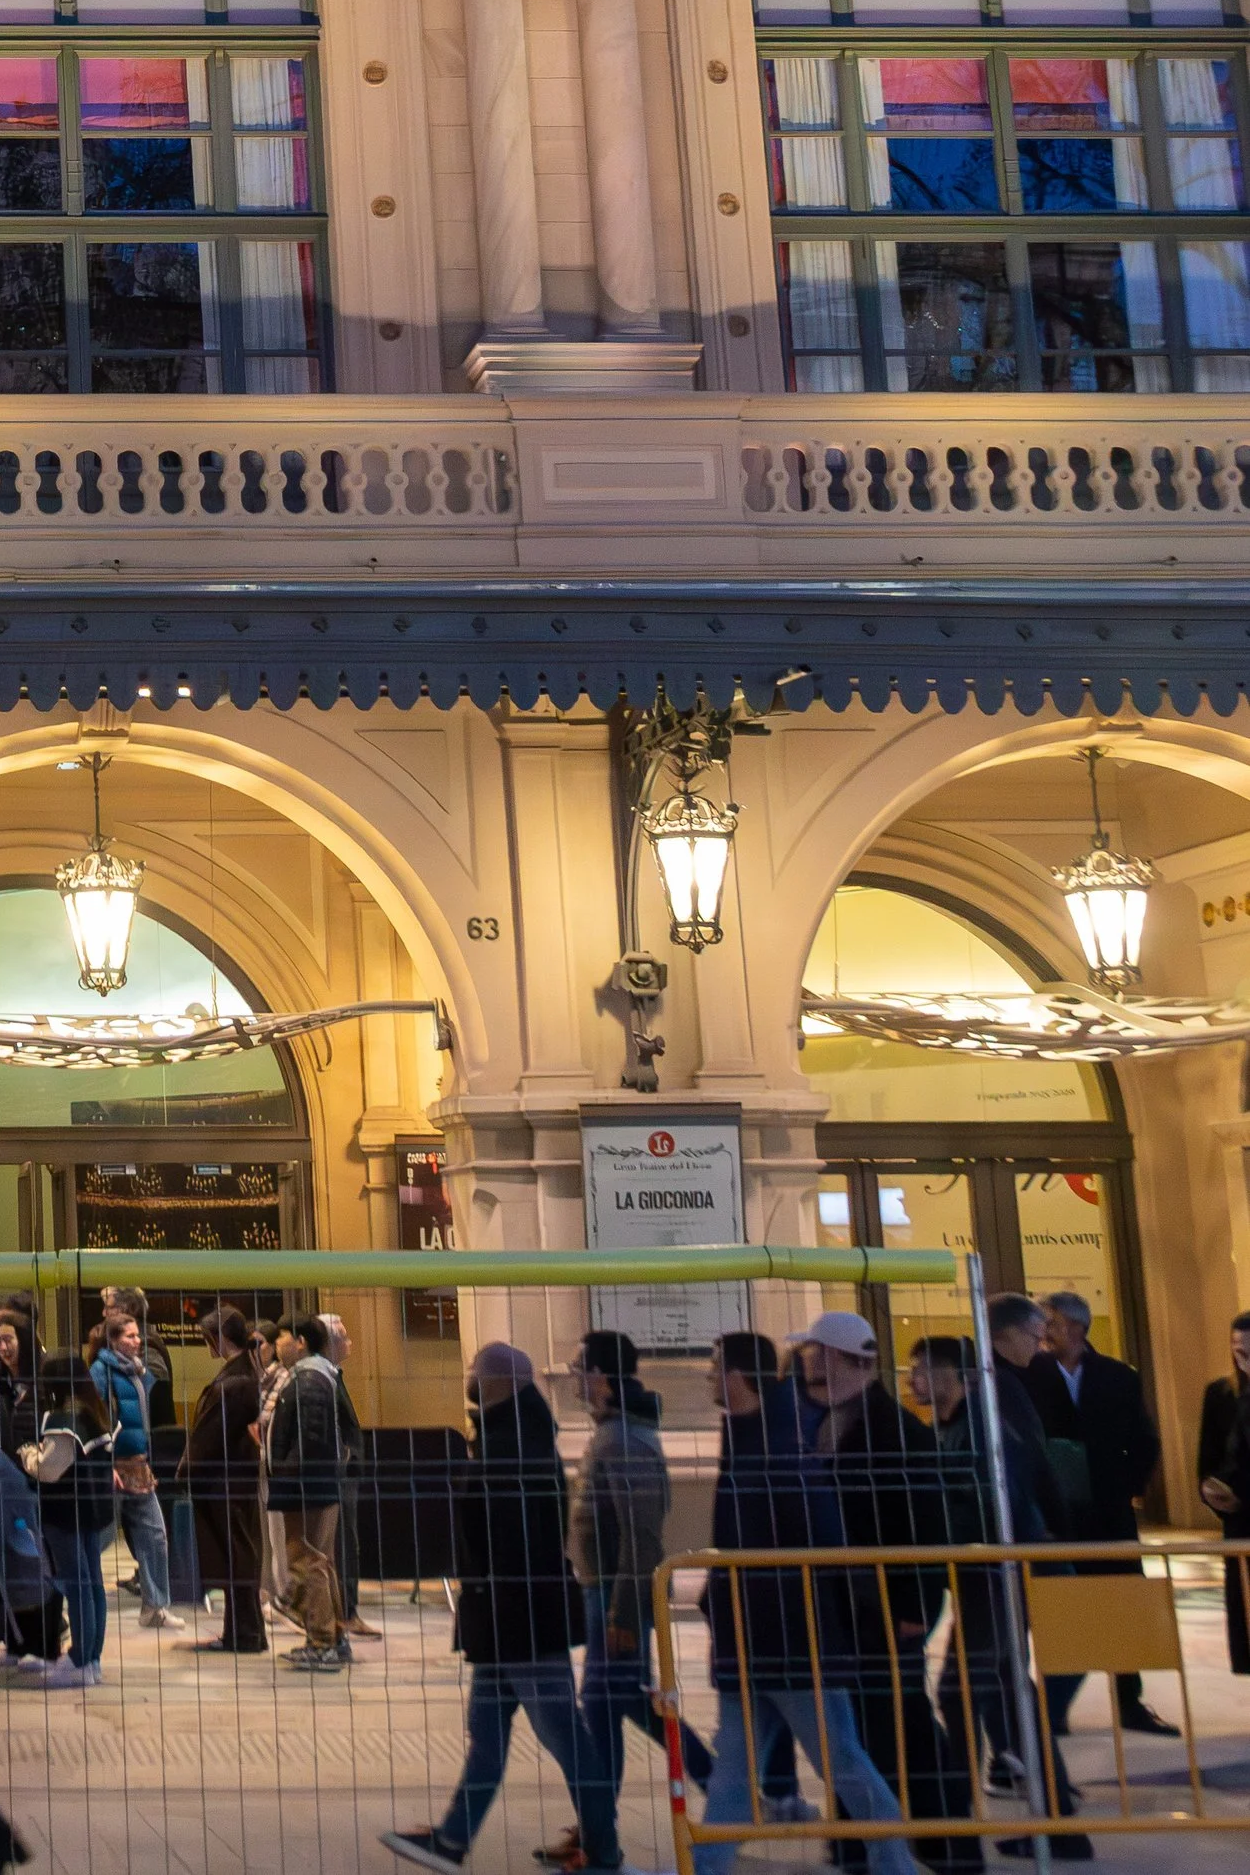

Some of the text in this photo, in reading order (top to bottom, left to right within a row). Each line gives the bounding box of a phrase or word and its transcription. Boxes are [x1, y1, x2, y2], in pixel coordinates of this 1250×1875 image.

[466, 916, 500, 941] 63
[614, 1190, 715, 1211] LA GIOCONDA
